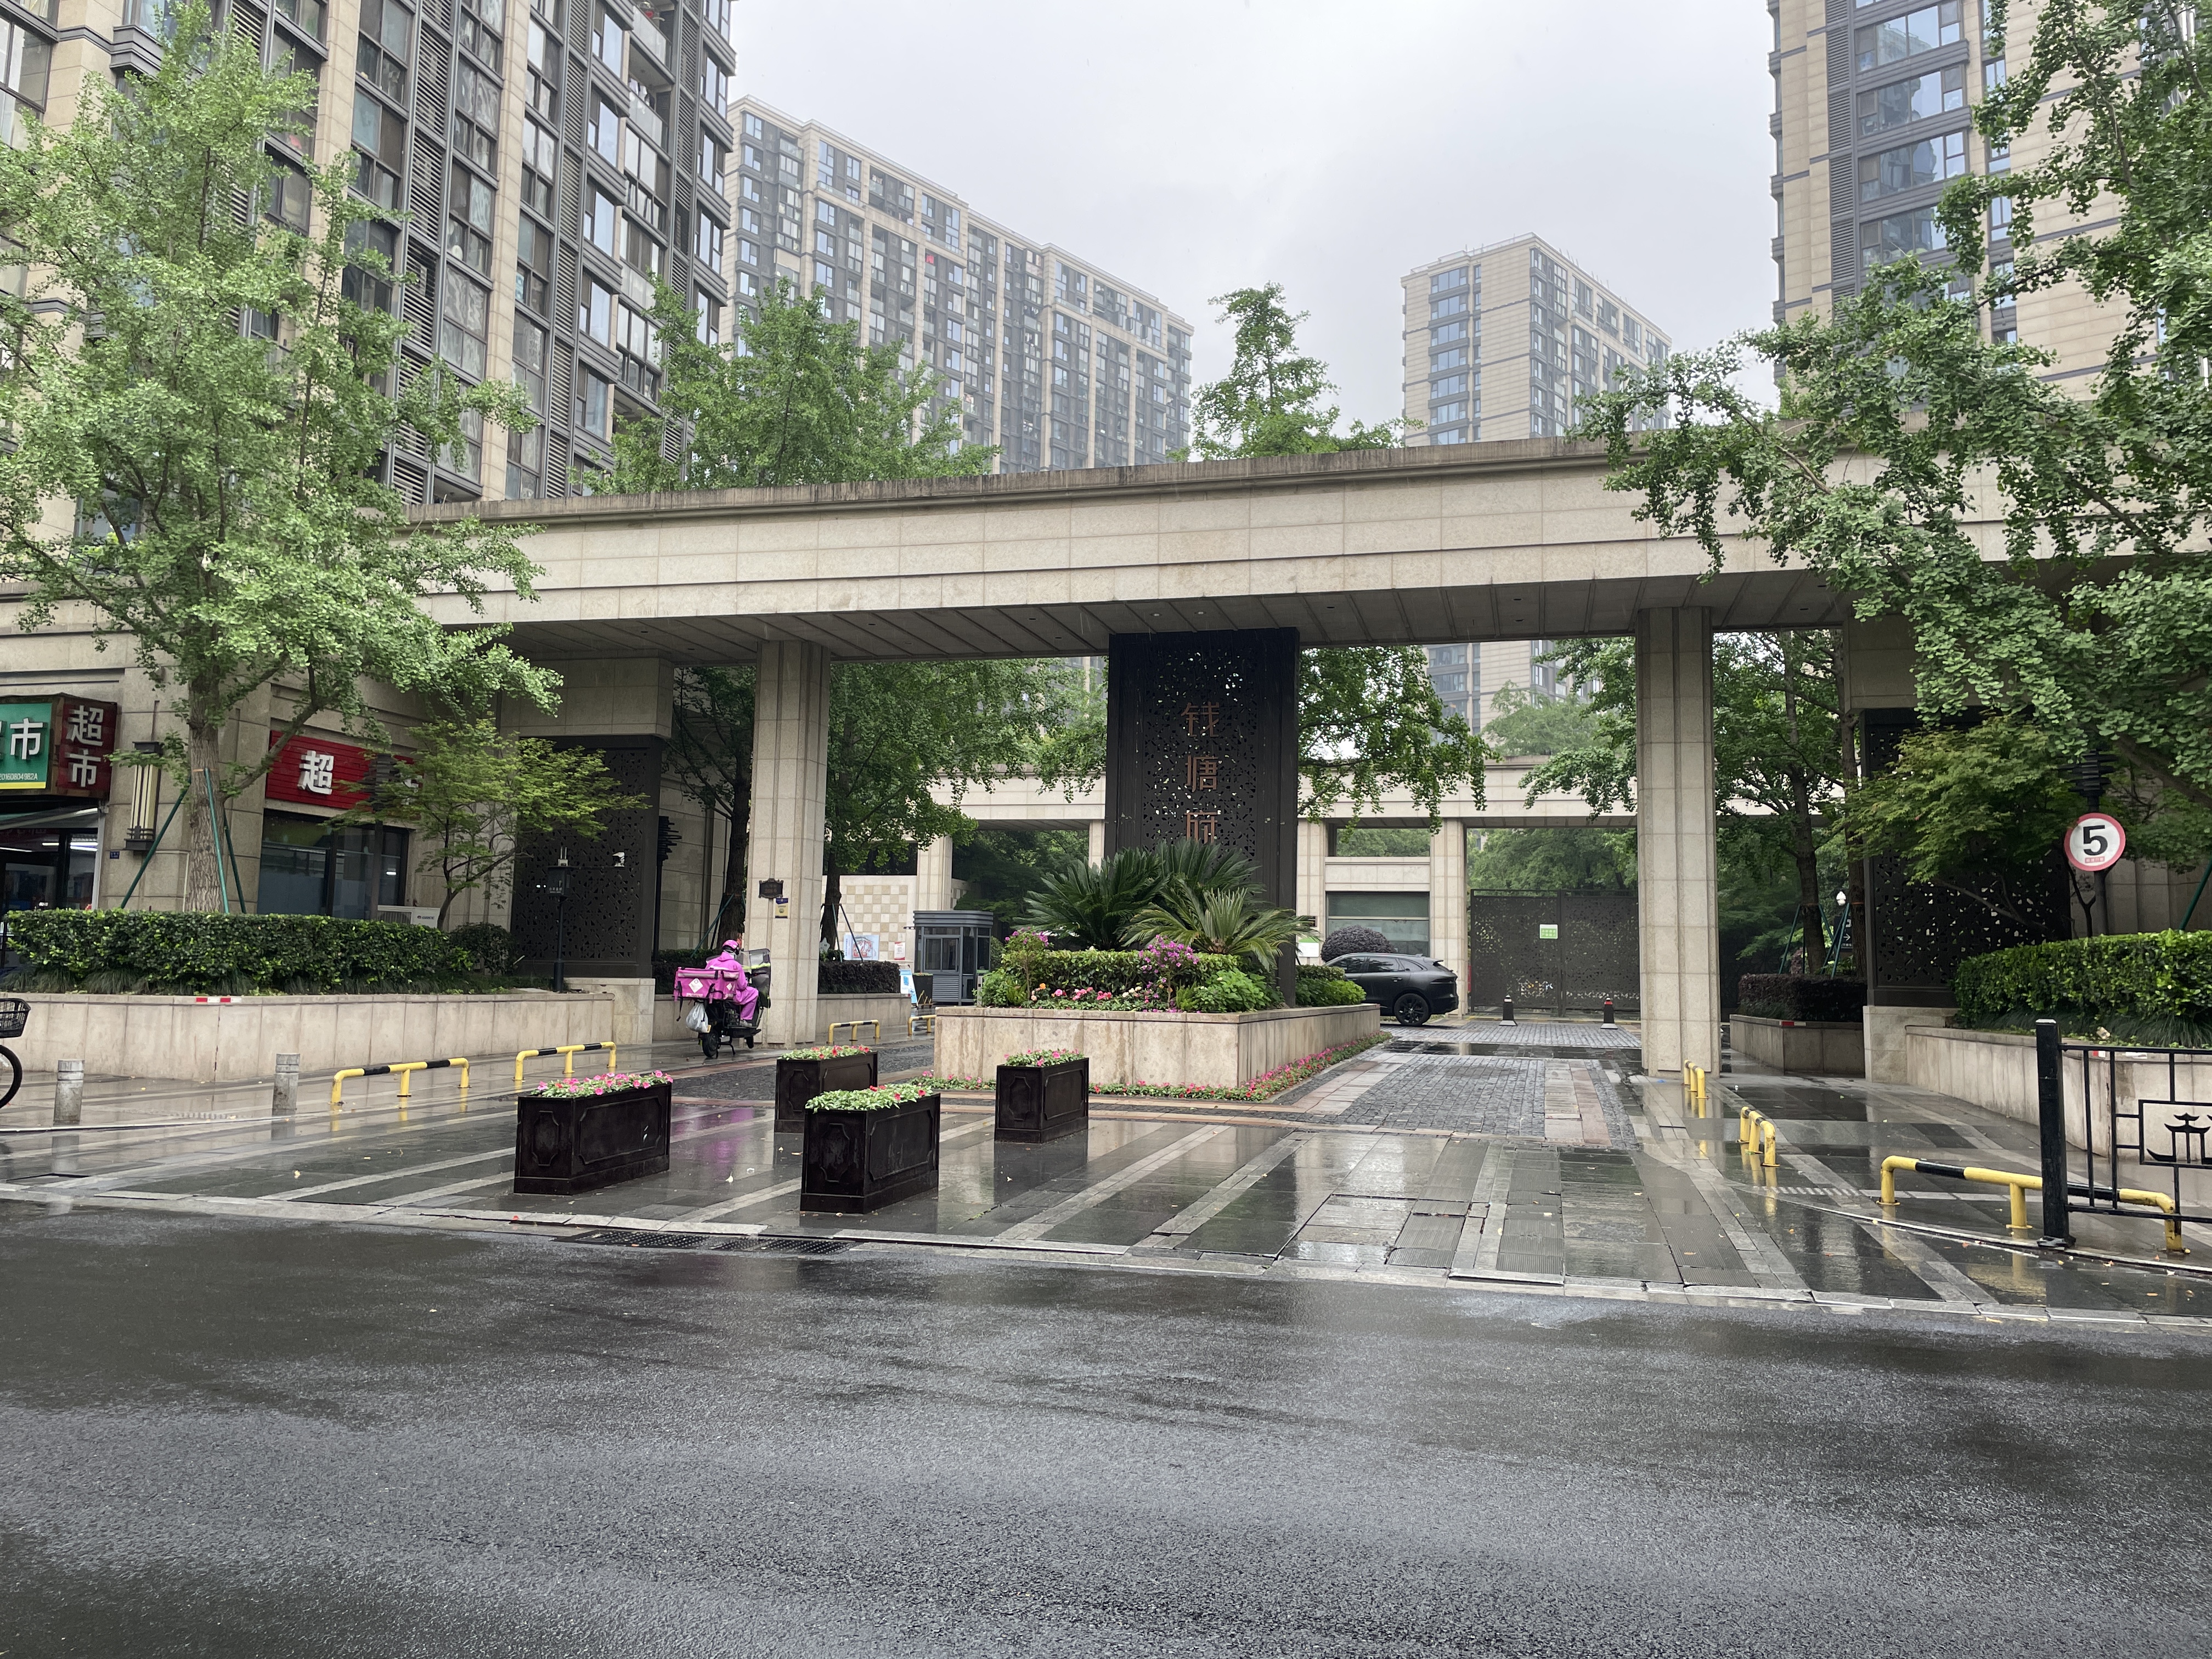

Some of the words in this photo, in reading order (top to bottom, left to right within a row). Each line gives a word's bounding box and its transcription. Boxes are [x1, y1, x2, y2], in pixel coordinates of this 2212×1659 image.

[0, 718, 44, 760] 市
[66, 705, 105, 787] 超市
[1181, 702, 1220, 844] 钱塘府
[2083, 825, 2108, 856] 5
